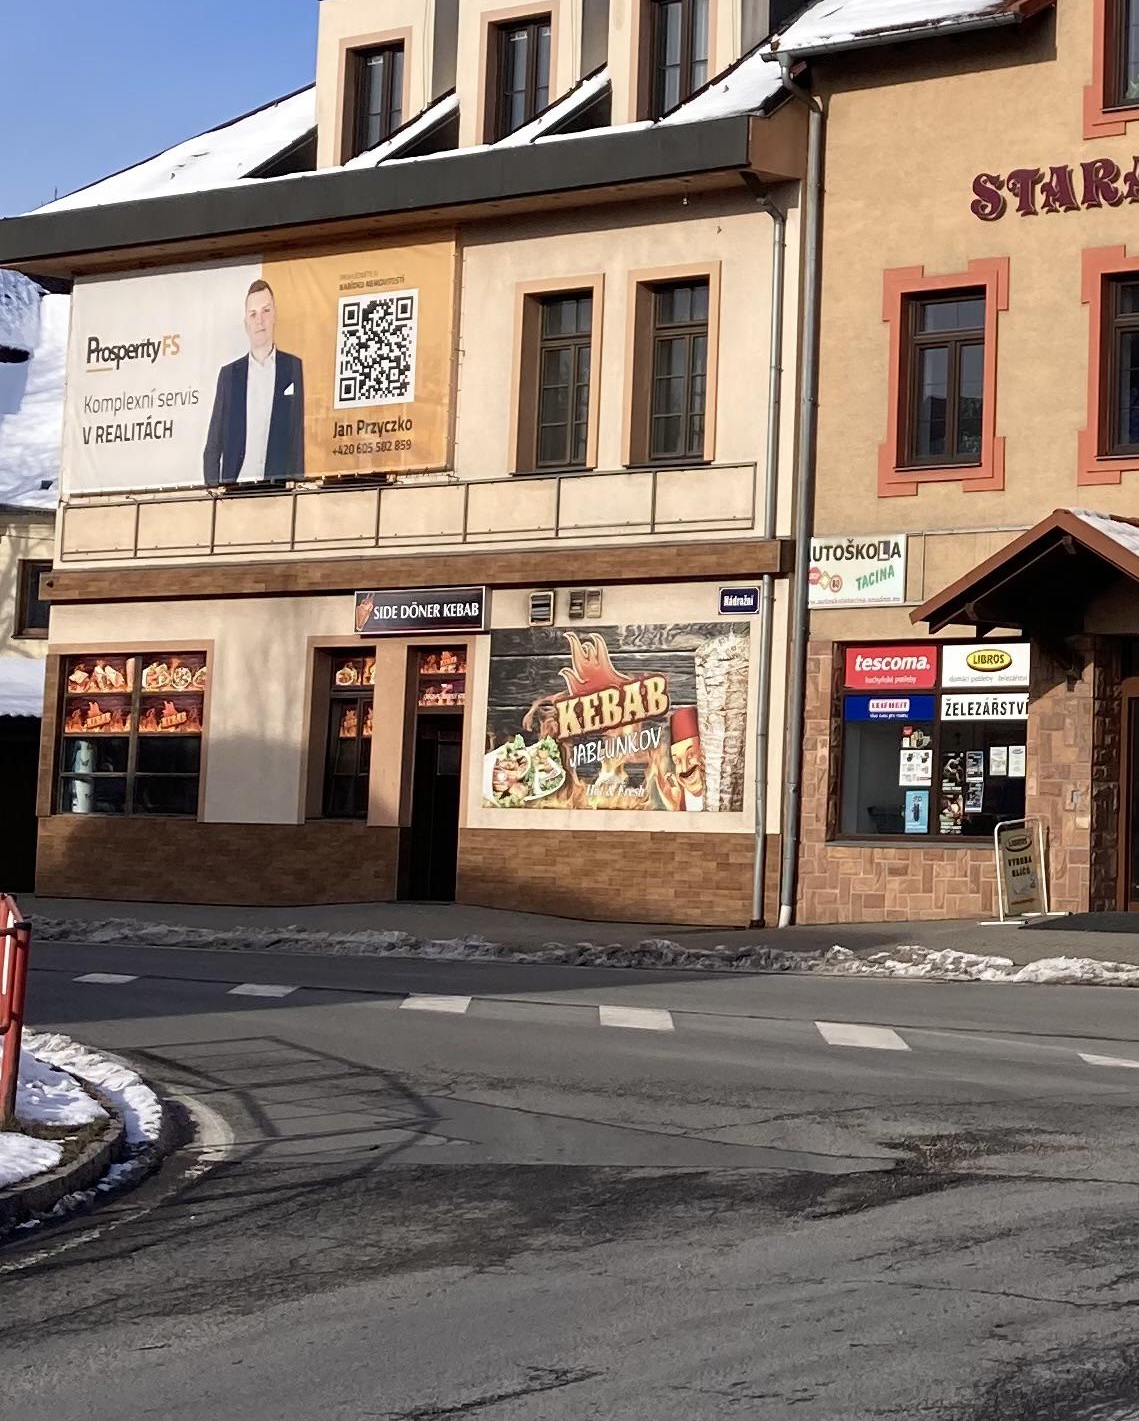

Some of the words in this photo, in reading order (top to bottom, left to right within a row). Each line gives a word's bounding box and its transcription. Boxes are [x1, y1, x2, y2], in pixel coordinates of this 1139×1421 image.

[84, 388, 156, 416] Komplexní
[158, 386, 199, 408] servis
[83, 426, 92, 444] V
[95, 415, 173, 444] REALITÁCH
[333, 421, 353, 438] Jan
[357, 415, 413, 437] Przyczko
[332, 444, 354, 455] +420
[812, 538, 901, 562] UTOŠKOLA
[856, 565, 895, 591] TACINA
[374, 605, 398, 620] SIDE
[400, 602, 441, 619] DÖNER
[443, 602, 479, 617] KEBAB
[723, 594, 755, 607] Nádražní
[973, 654, 1005, 665] LIBROS
[555, 676, 669, 739] KEBAB
[569, 727, 662, 767] JABLUNKOV
